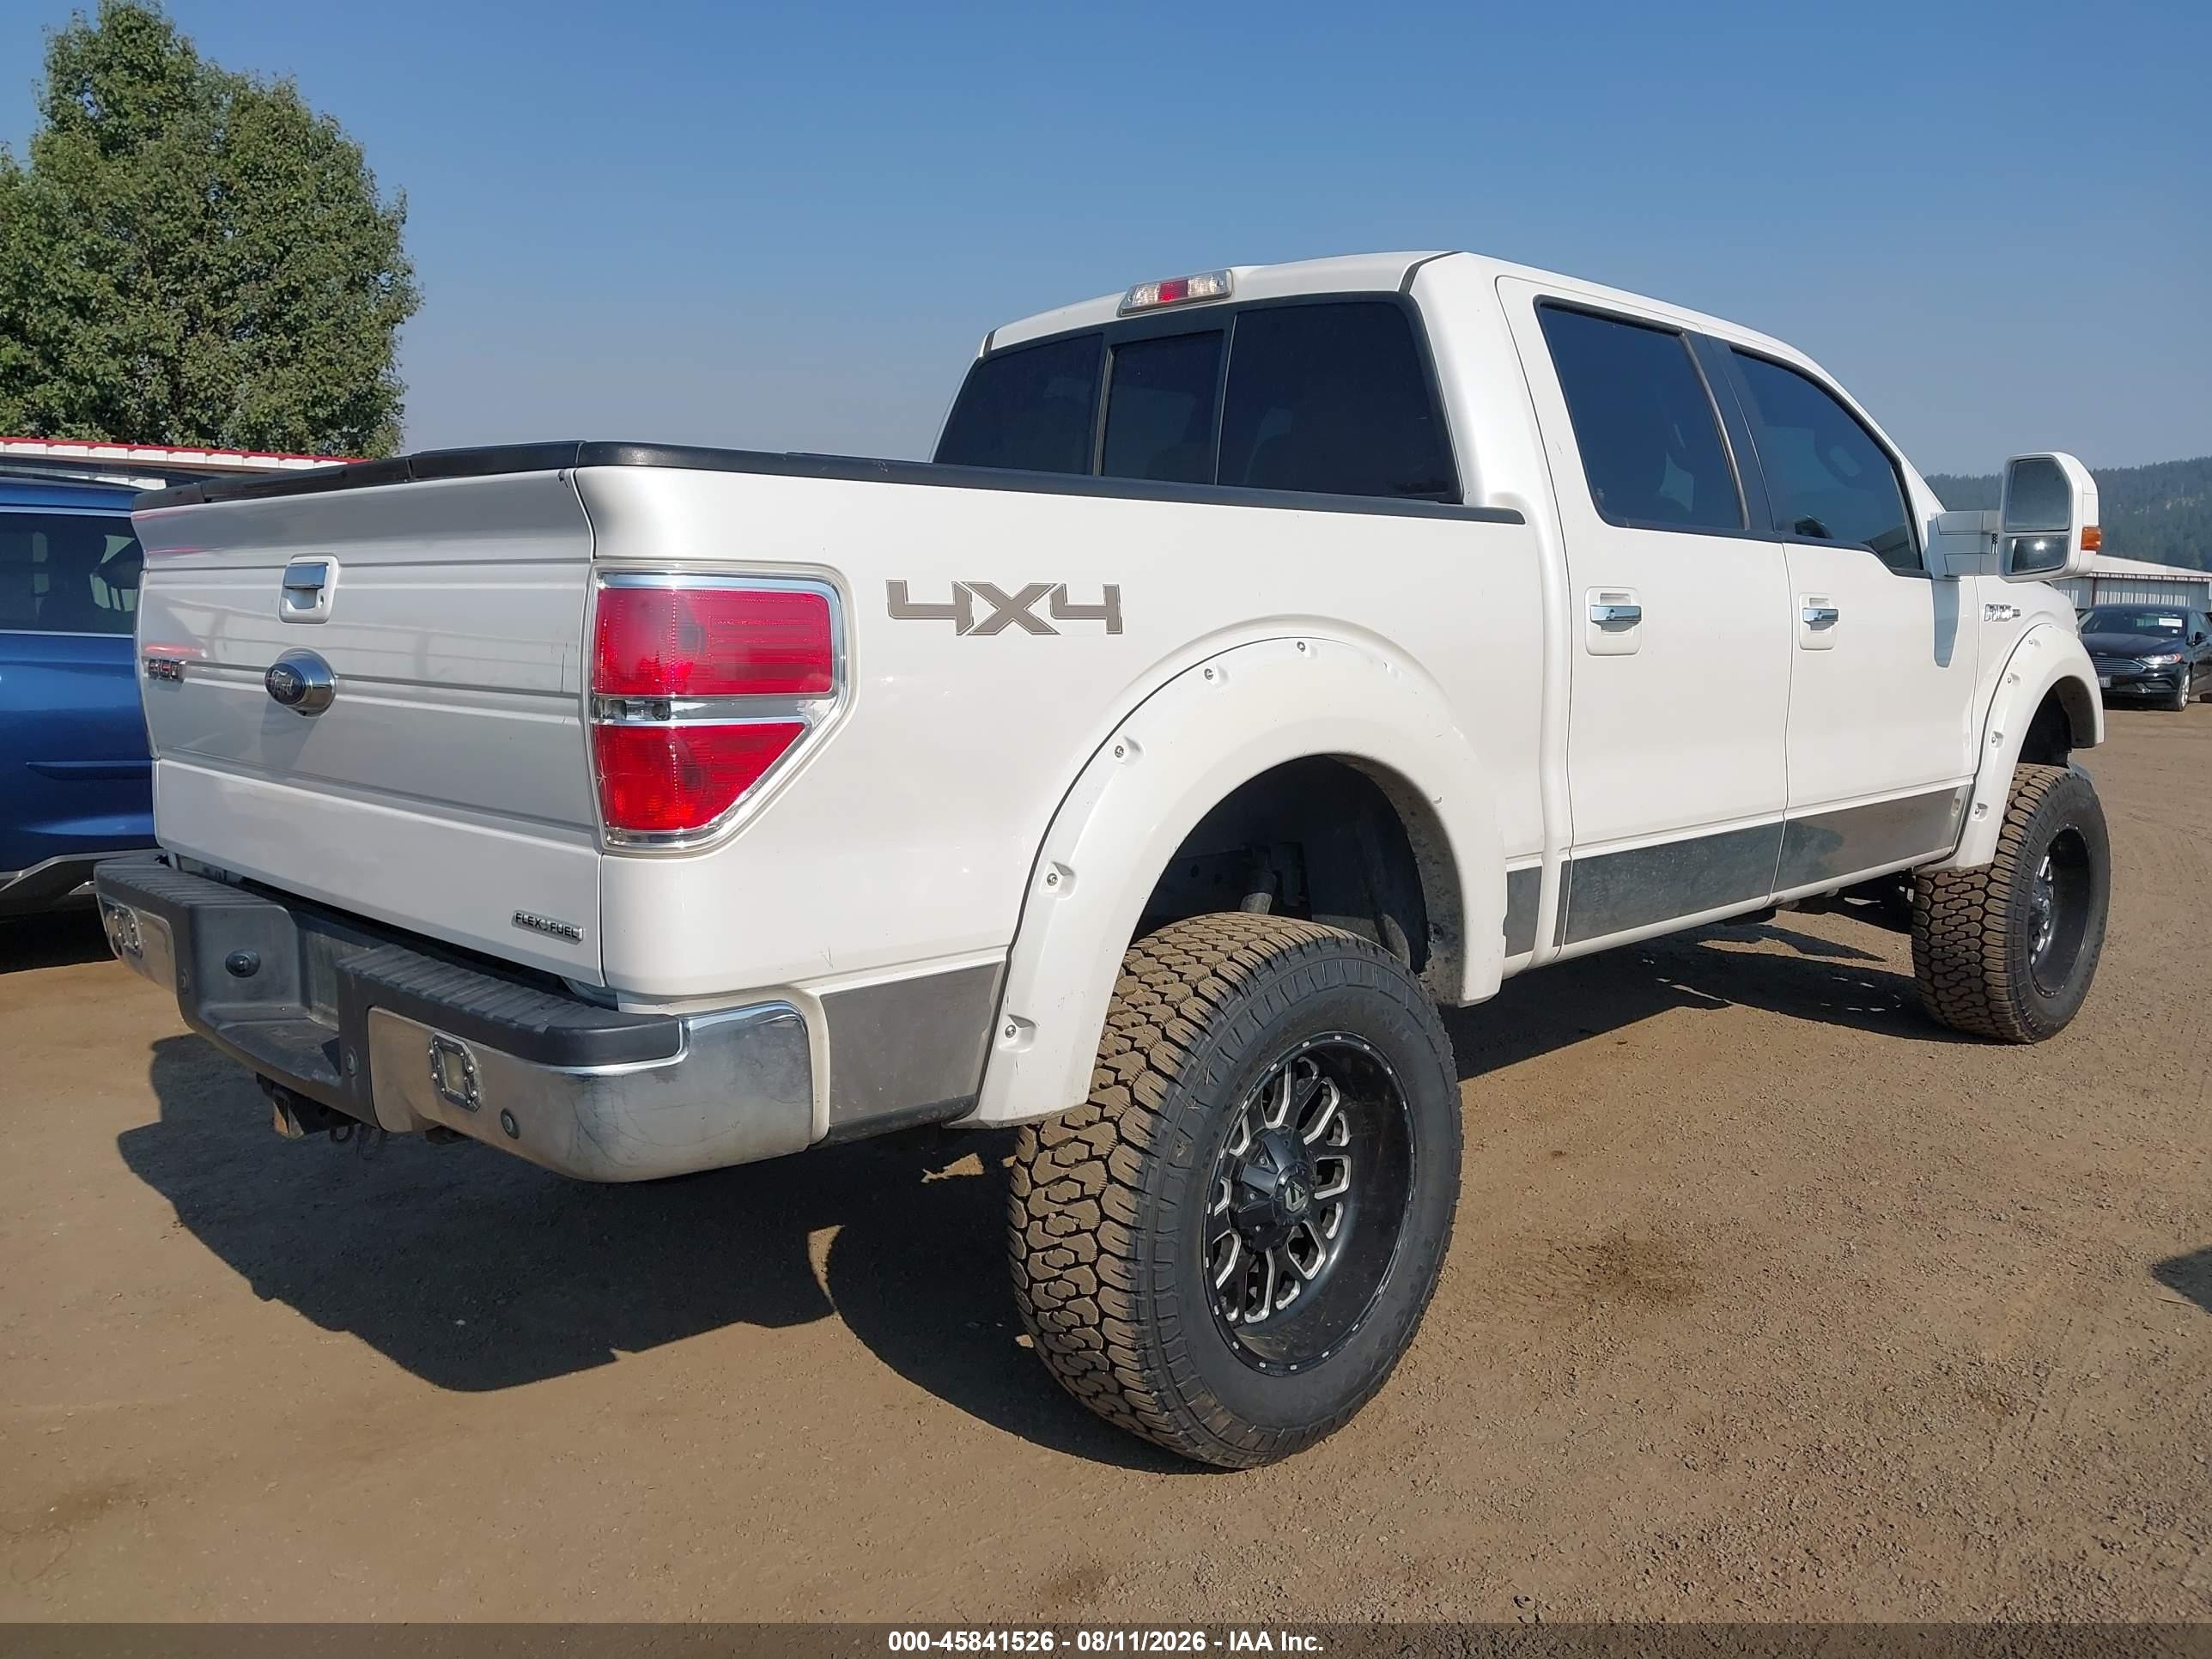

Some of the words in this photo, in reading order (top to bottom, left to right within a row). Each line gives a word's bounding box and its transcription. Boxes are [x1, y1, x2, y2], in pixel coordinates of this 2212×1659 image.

[266, 669, 295, 696] Ford
[515, 912, 543, 929] FLEX
[550, 922, 579, 939] FUEL
